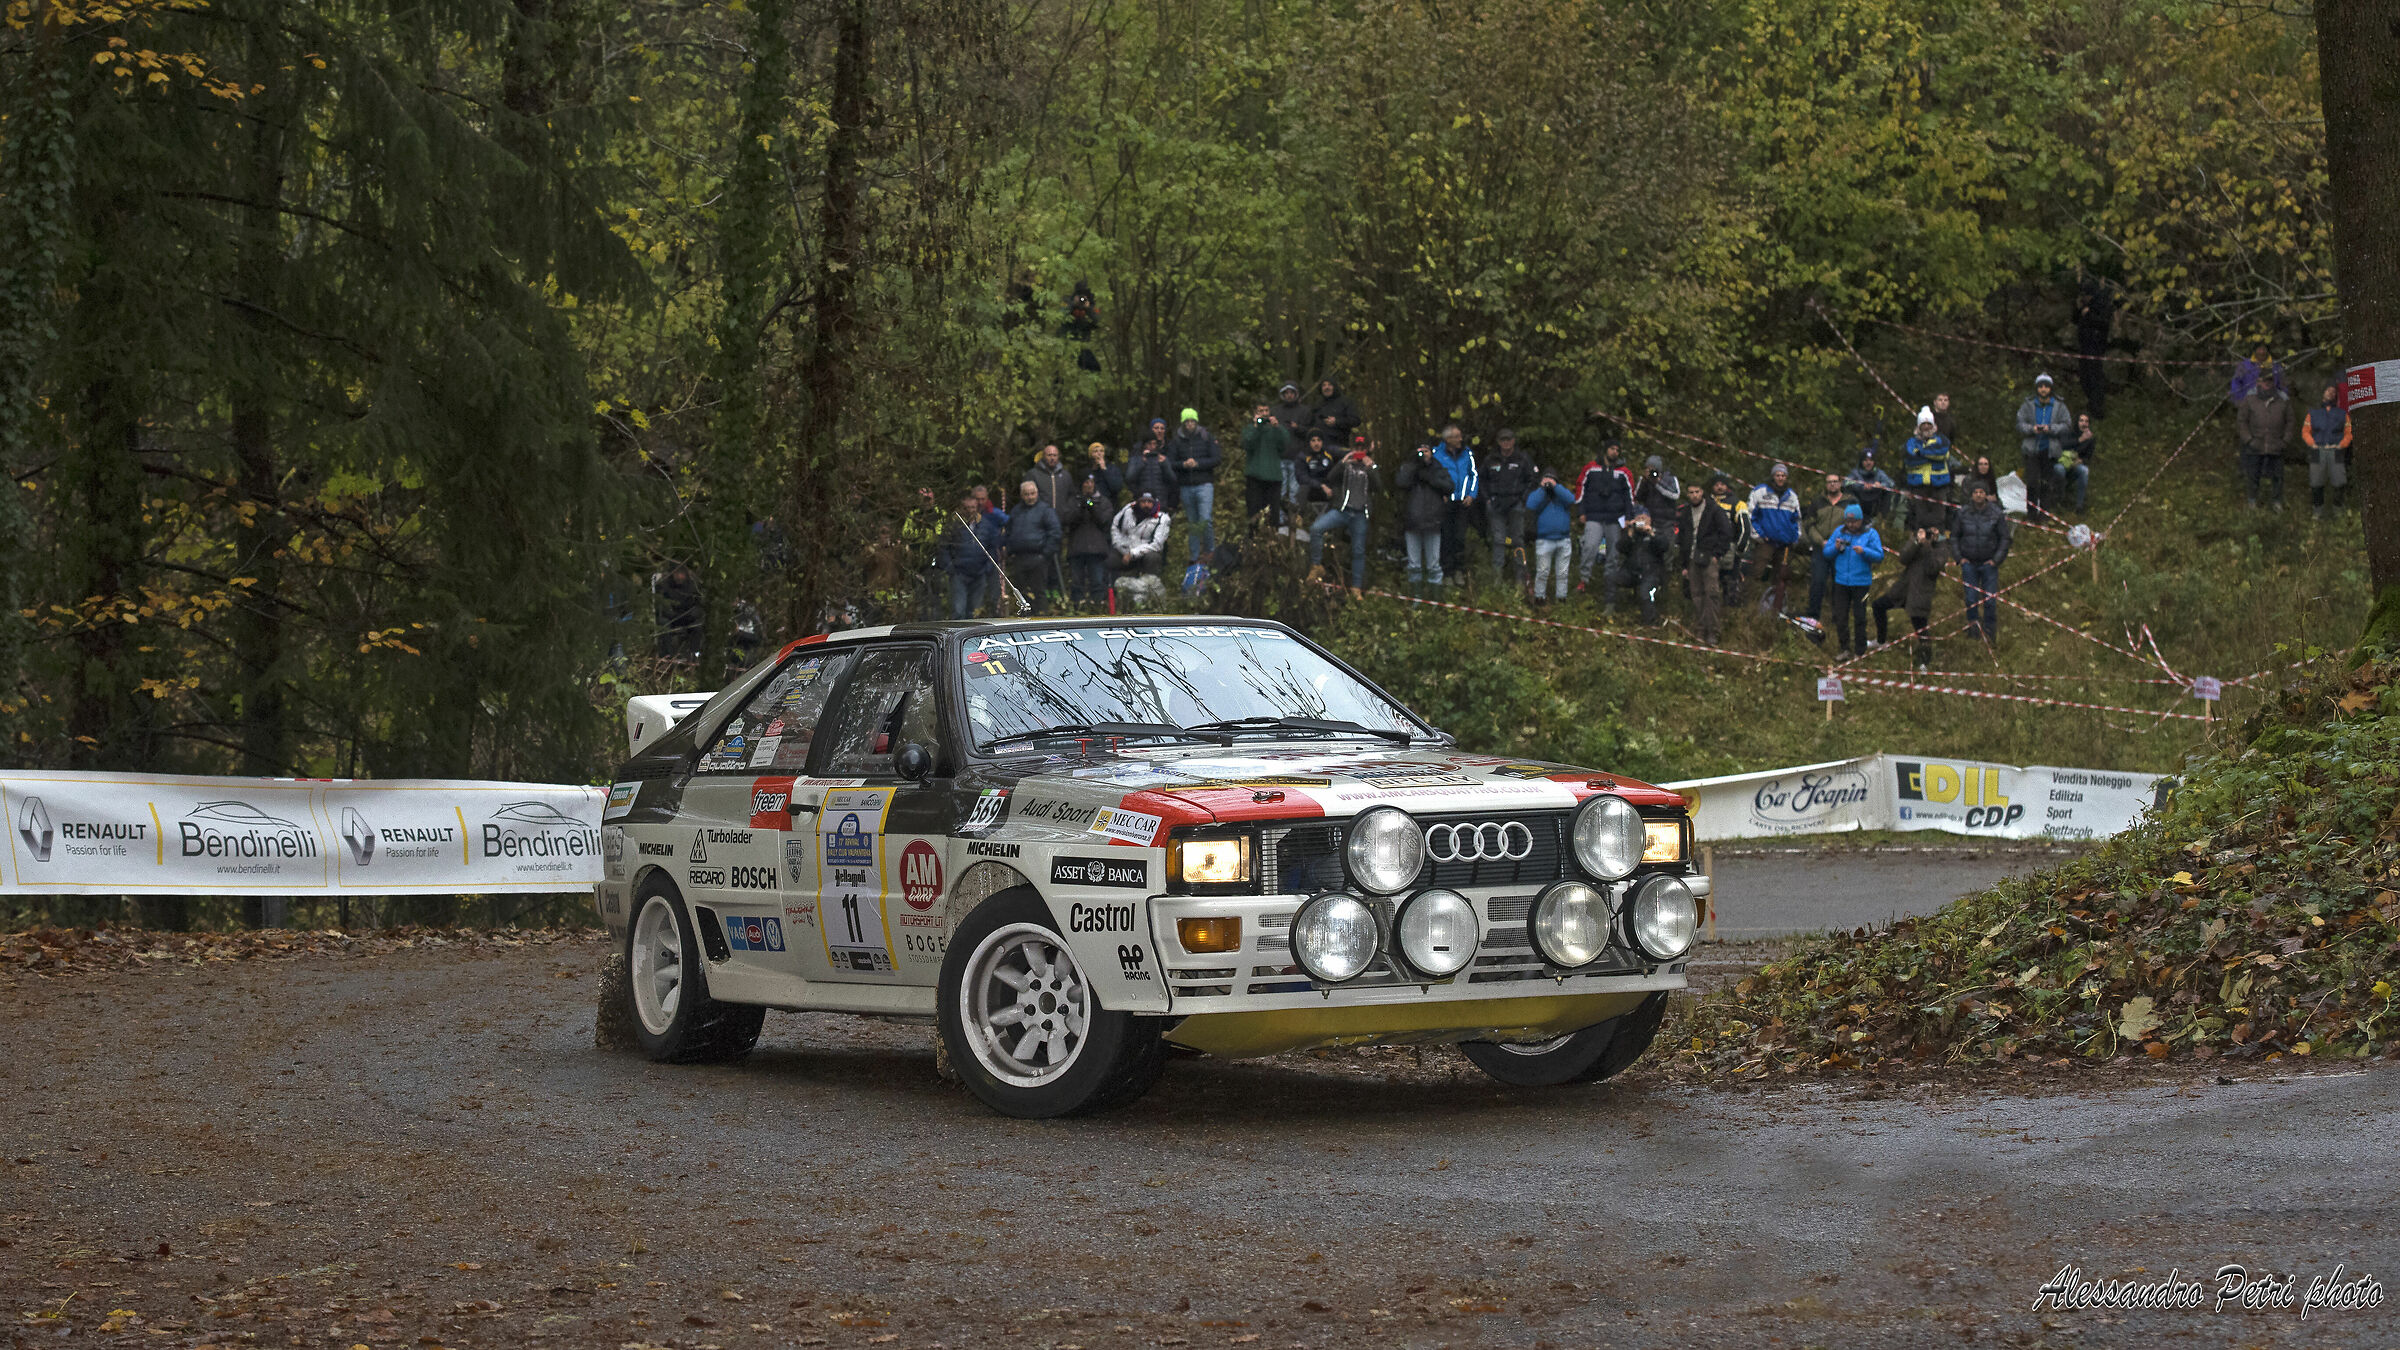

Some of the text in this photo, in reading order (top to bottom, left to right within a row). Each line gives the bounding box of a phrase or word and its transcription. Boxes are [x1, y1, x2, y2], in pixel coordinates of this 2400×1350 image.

[1097, 626, 1289, 641] quattro
[981, 660, 1008, 675] 11
[709, 760, 747, 771] quattro
[2052, 772, 2132, 790] Vendita Noleggio
[1791, 772, 1868, 813] Scapin
[2049, 789, 2084, 803] Edilizia
[750, 789, 787, 816] freem
[969, 797, 1003, 824] 569
[1018, 798, 1097, 824] Audi Sport
[1965, 804, 2024, 828] CDP
[2046, 806, 2073, 821] Sport
[1110, 812, 1157, 833] MEC CAR
[2042, 823, 2094, 838] Spettacolo
[62, 823, 147, 841] RENAULT
[178, 821, 318, 858] Bendinelli
[381, 827, 454, 843] RENAULT
[482, 823, 603, 858] Bendinelli
[707, 828, 753, 844] Turbolader
[66, 843, 127, 856] Passion for life
[386, 847, 440, 858] Passion for life
[639, 842, 674, 857] MICHELIN
[967, 841, 1021, 858] MICHELIN
[217, 863, 281, 874] www.bendinelli.it
[517, 861, 573, 872] www.bendinelli.it
[906, 853, 937, 886] AM
[1054, 865, 1086, 880] ASSET
[1108, 867, 1144, 883] BANCA
[689, 866, 777, 889] RECARO BOSCH
[908, 886, 935, 903] CARS
[842, 893, 864, 943] 11
[1070, 902, 1136, 932] Castrol
[728, 926, 746, 940] VAG
[906, 934, 946, 953] BOGE
[1123, 971, 1151, 981] RACING
